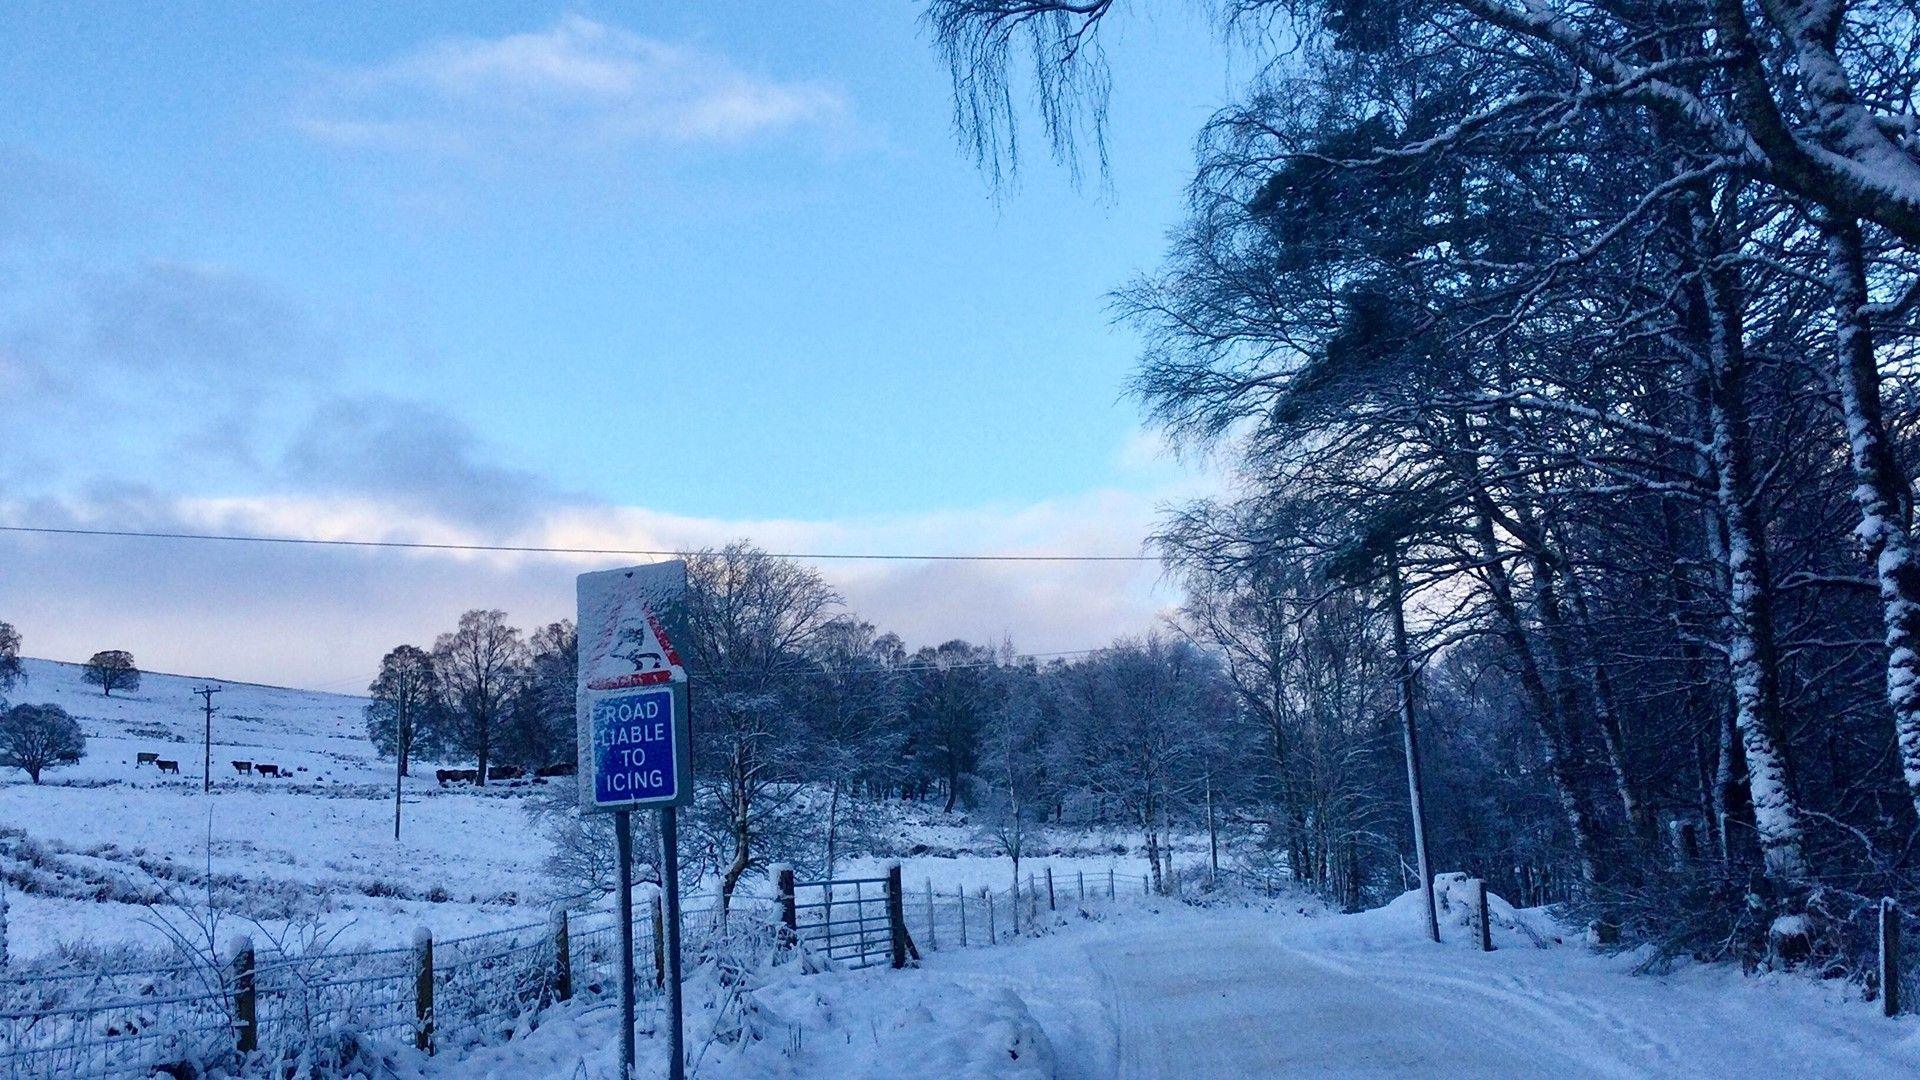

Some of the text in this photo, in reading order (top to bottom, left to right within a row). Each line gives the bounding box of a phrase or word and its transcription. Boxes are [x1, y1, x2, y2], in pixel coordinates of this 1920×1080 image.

[605, 701, 658, 723] ROAD
[601, 723, 664, 746] LIABLE
[621, 748, 646, 767] TO
[607, 770, 663, 792] ICING
